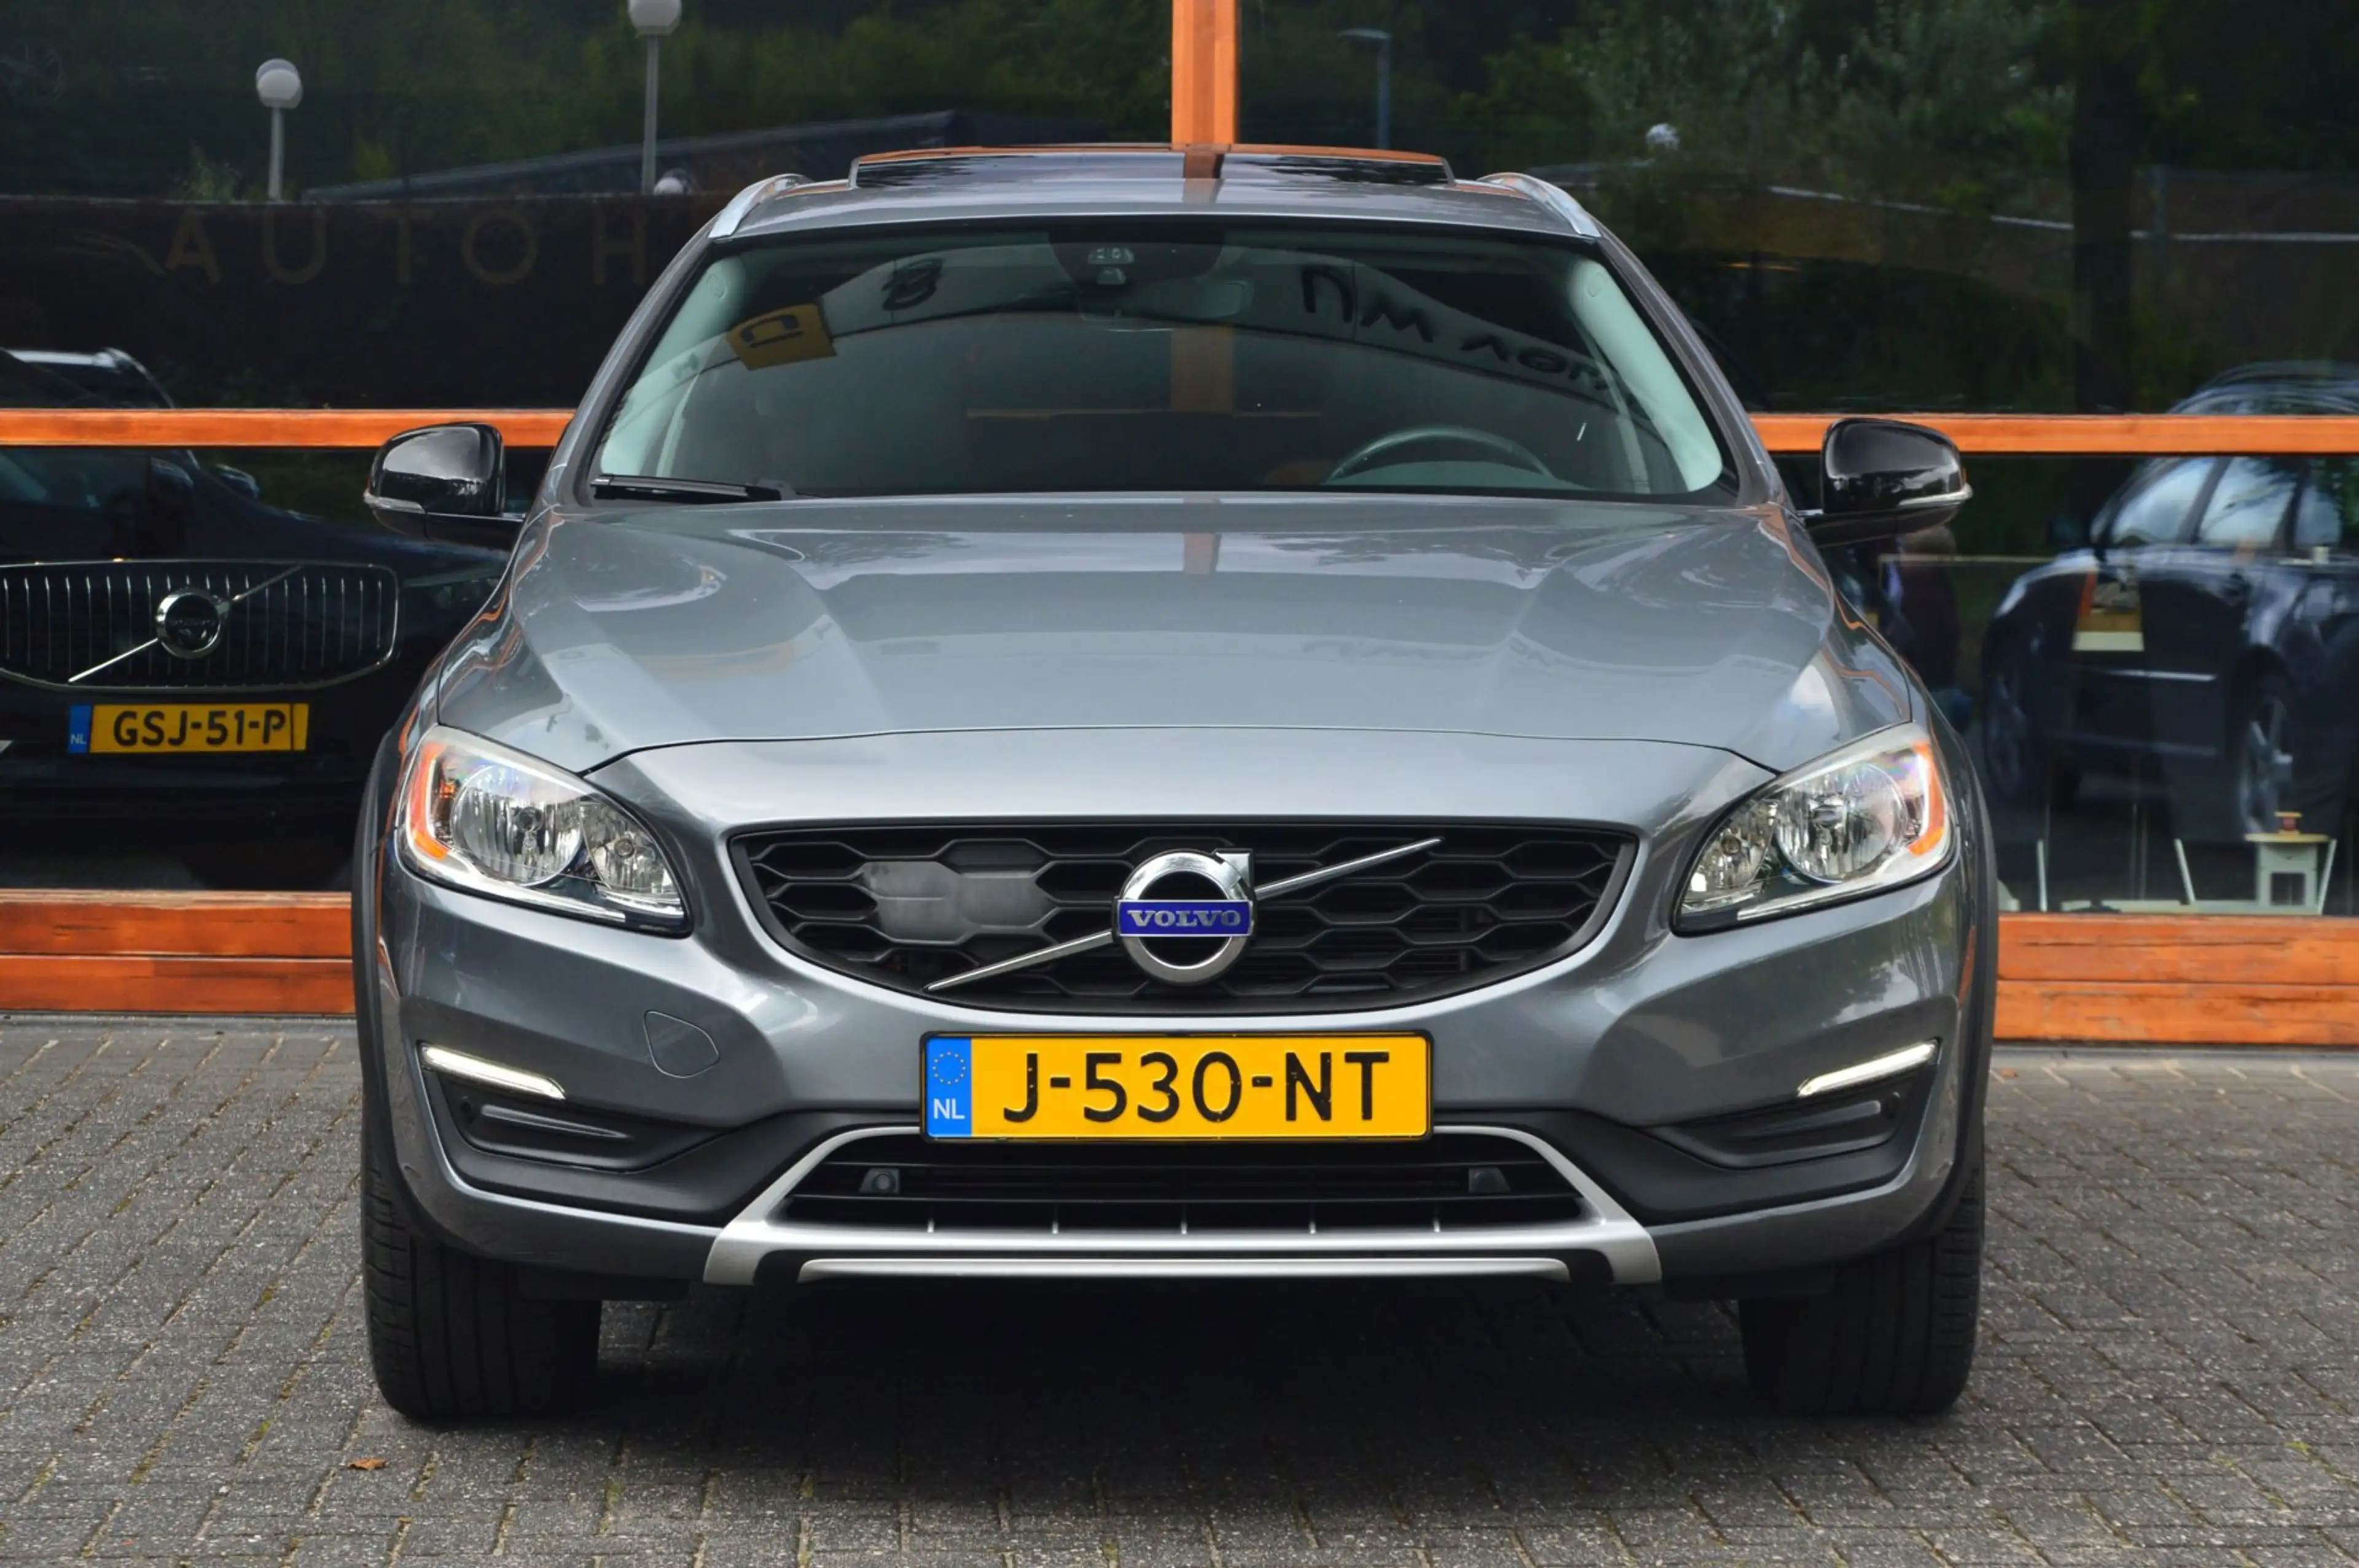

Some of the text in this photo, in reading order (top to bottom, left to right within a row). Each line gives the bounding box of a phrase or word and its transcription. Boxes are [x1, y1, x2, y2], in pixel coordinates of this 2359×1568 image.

[165, 208, 651, 285] AUTOH
[71, 710, 286, 746] NL GSJ-51-P
[1127, 910, 1241, 927] VOLVO
[933, 1051, 1390, 1123] NL J-530-NT
